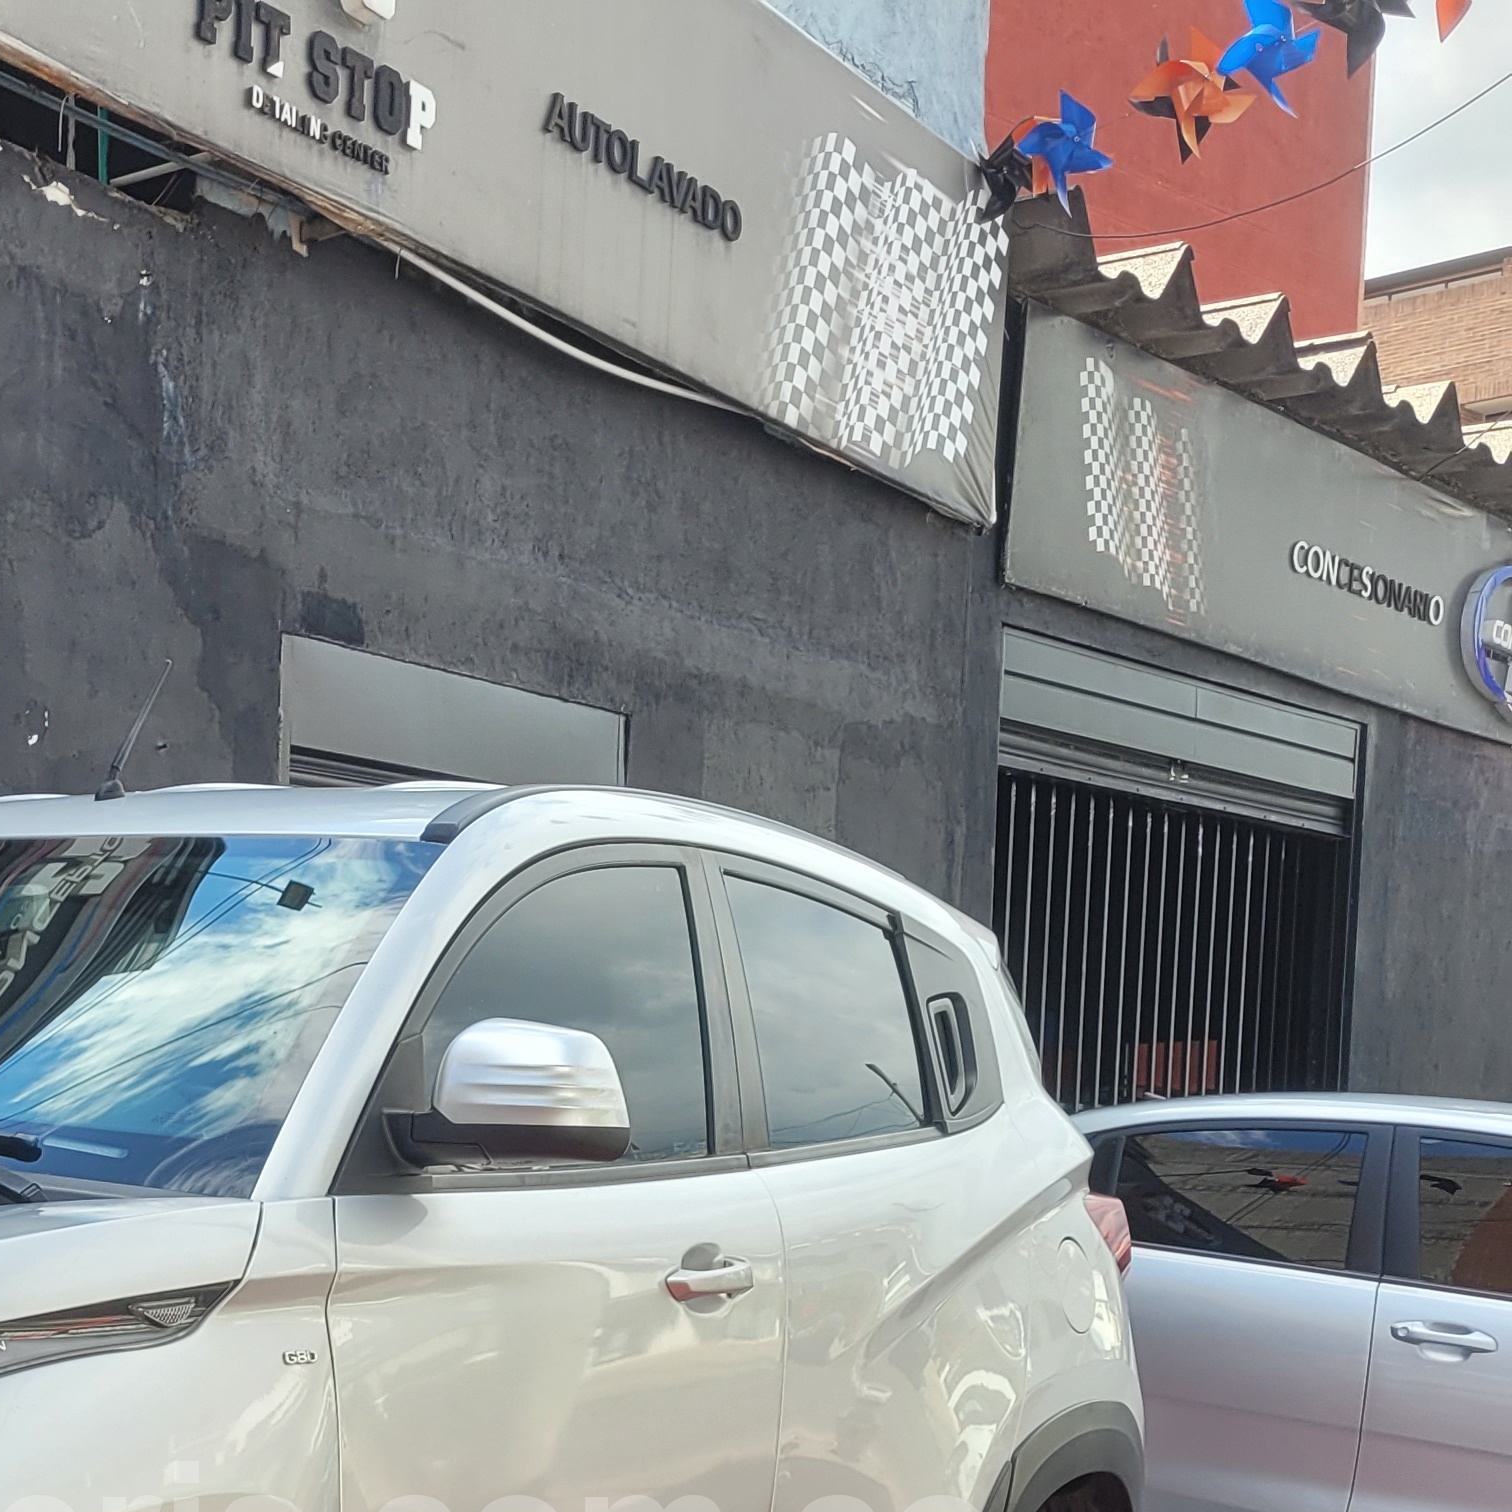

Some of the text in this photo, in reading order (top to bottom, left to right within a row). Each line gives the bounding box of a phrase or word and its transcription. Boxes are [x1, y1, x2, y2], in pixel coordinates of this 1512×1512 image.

[196, 0, 436, 150] PIT STOP
[331, 130, 390, 175] CENTER
[543, 91, 742, 242] AUTOLAVADO
